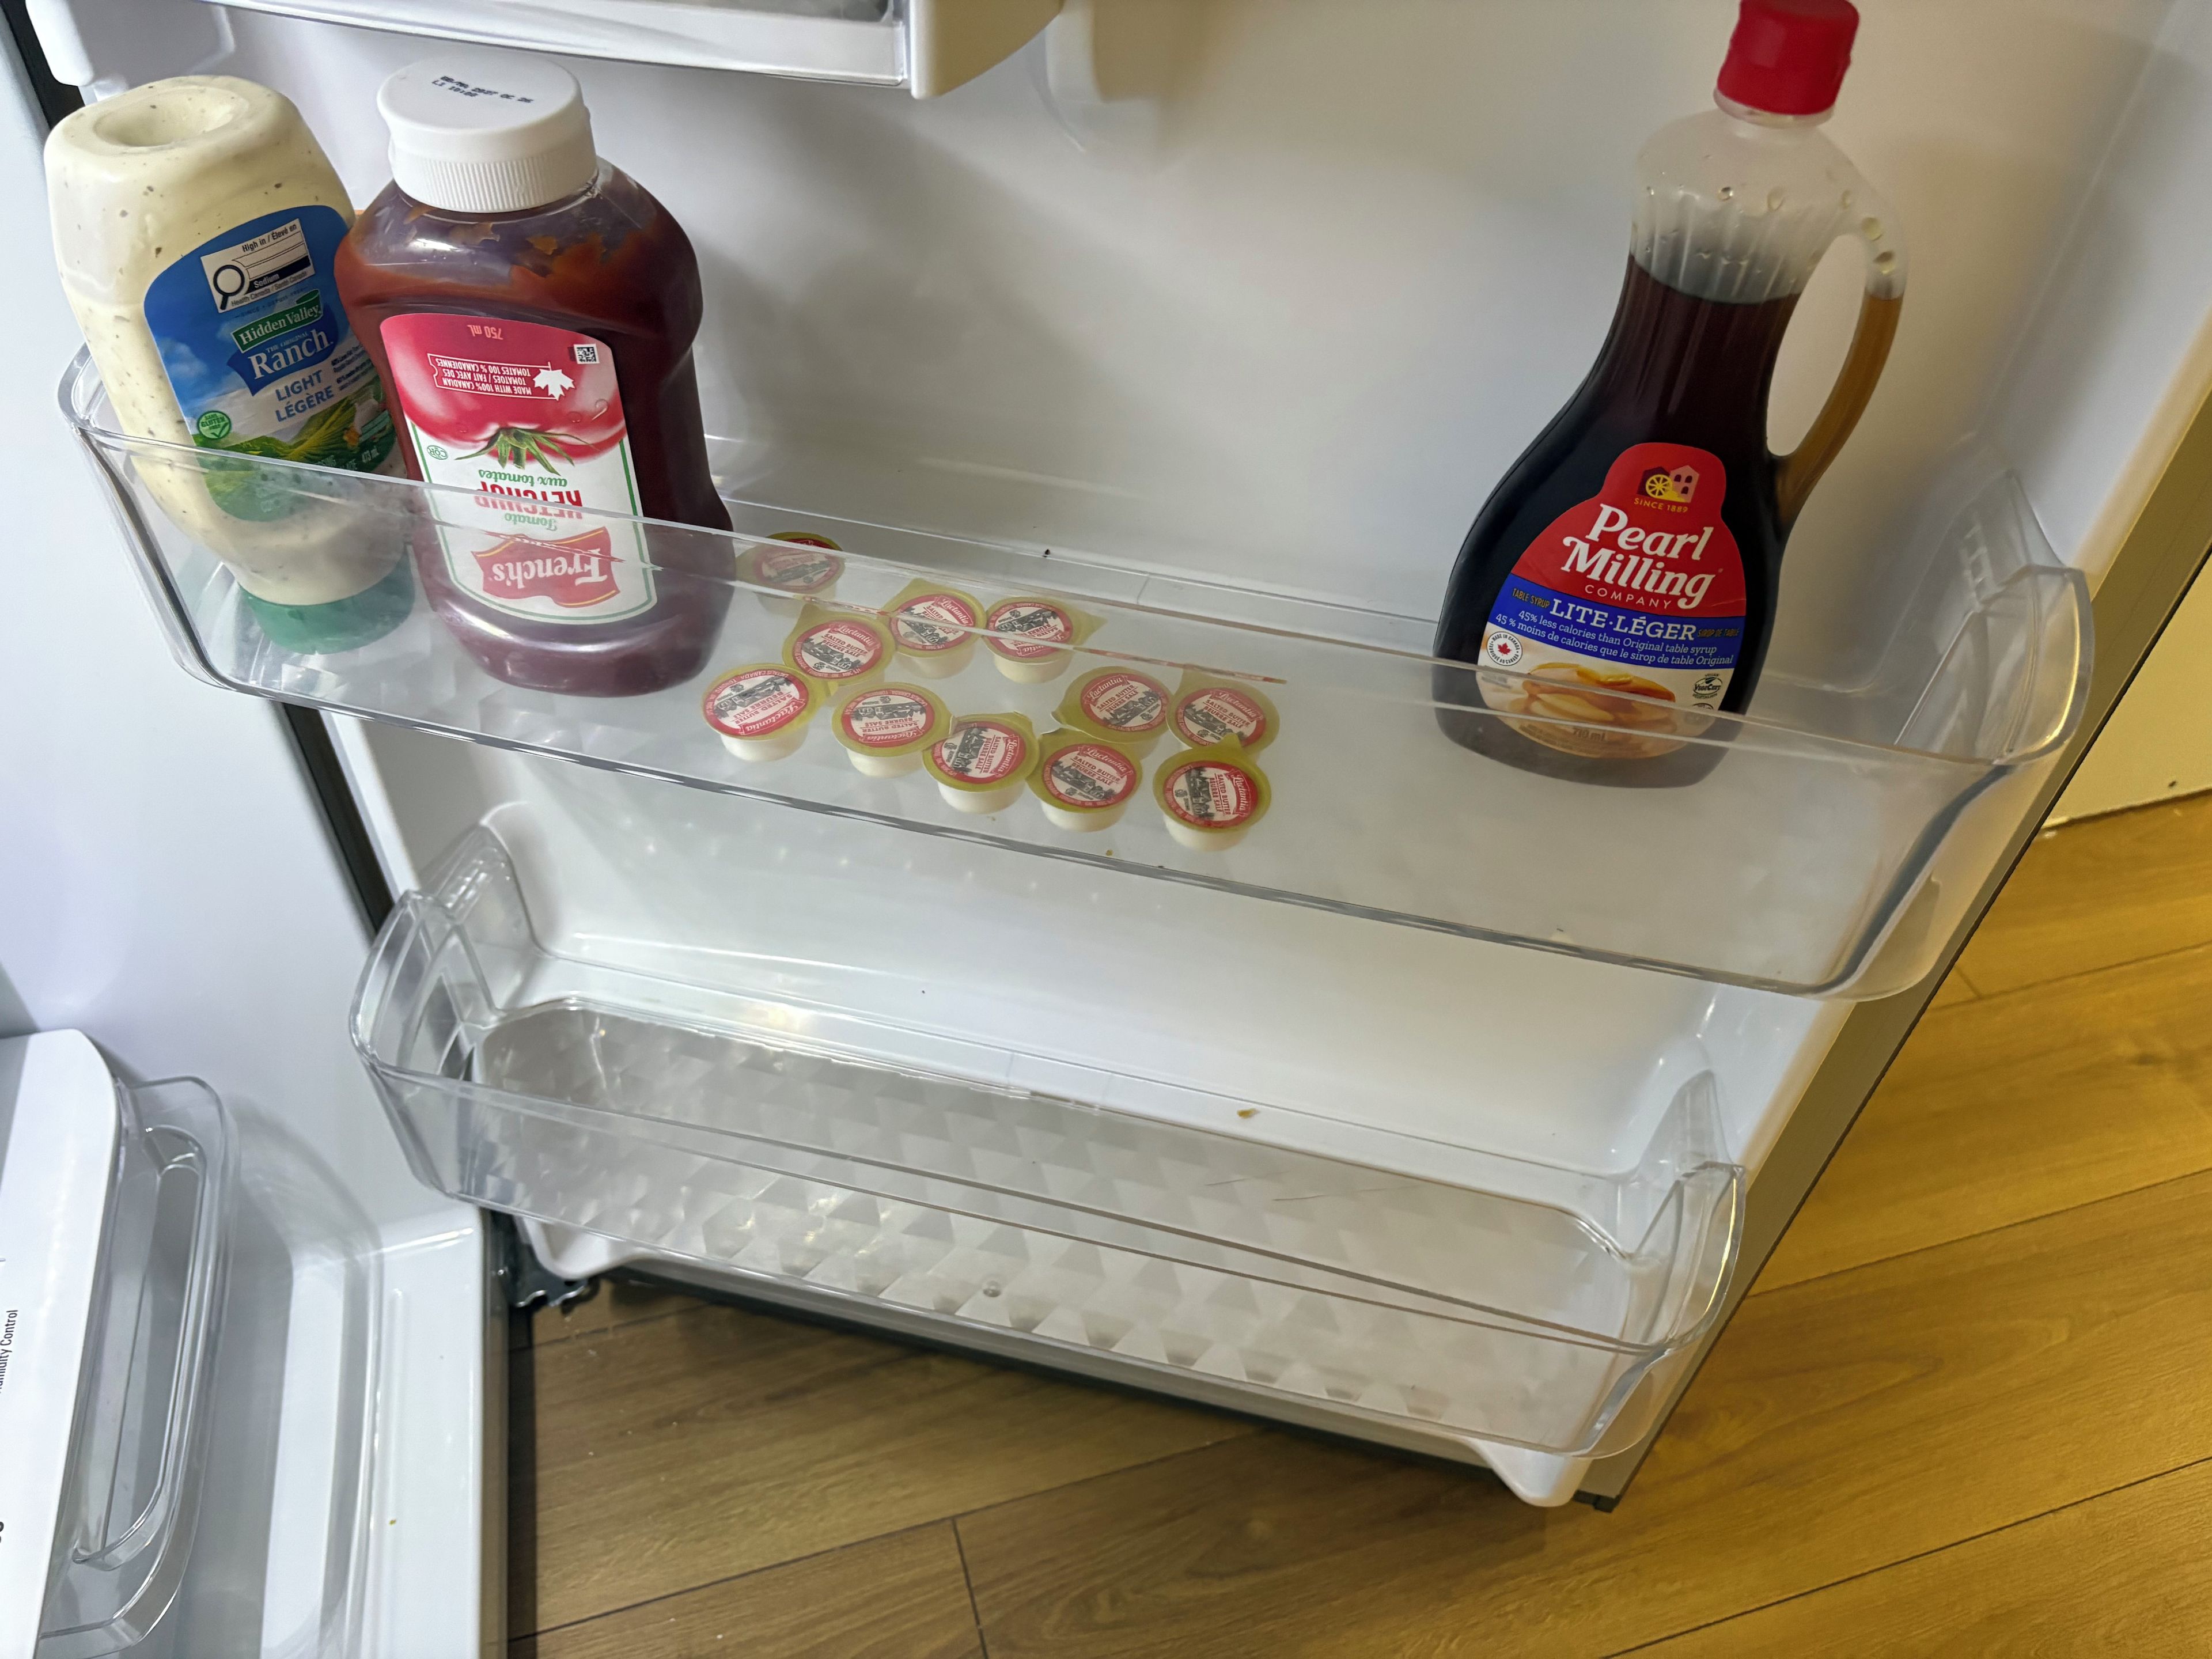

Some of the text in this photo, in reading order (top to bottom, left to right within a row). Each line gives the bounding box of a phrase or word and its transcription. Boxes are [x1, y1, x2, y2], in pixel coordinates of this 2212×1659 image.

[242, 241, 258, 252] High
[253, 274, 279, 288] Sodium
[232, 295, 249, 306] Health
[250, 285, 270, 300] Canada
[238, 317, 287, 344] Hidden
[286, 305, 321, 324] Valley
[467, 324, 503, 340] 750 mL
[266, 331, 309, 353] THE ORIGINAL
[248, 329, 330, 380] Ranch
[435, 358, 531, 377] TOMATES 100 % CANADIENNES
[443, 368, 455, 377] DES
[457, 370, 472, 380] AVEC
[474, 373, 488, 382] FAIT
[275, 370, 323, 401] LIGHT
[442, 377, 532, 395] MADE WITH 100% CANADIAN
[494, 376, 527, 385] TOMATOES
[275, 385, 334, 422] LÉGÈRE
[200, 416, 226, 427] GLUTEN
[478, 469, 567, 487] aux tomates
[474, 480, 583, 519] KETCHUP
[1634, 498, 1688, 513] SINCE 1889
[504, 512, 558, 532] Tomato
[1585, 503, 1714, 560] Pearl
[492, 547, 608, 589] French's
[1560, 536, 1716, 609] Milling
[1512, 588, 1550, 608] TABLE SYRUP
[1585, 585, 1672, 609] COMPANY
[938, 598, 969, 625] Lactantia
[824, 634, 846, 646] SALTED
[837, 624, 874, 646] Lactantia
[1496, 613, 1734, 666] 45 % moins de calories que le sirop de table Original
[1508, 636, 1520, 650] CANADA
[1518, 611, 1717, 656] 45% less calories than Original table syrup
[741, 670, 766, 679] CANADA
[1087, 677, 1123, 700] Lactantia
[749, 691, 784, 710] BEURRE
[761, 694, 793, 711] SALTED
[1097, 697, 1115, 710] SALTED
[1206, 699, 1228, 713] SALTED
[1219, 692, 1257, 717] Lactantia
[745, 702, 799, 732] Lactantia
[866, 730, 916, 741] Lactantia
[990, 736, 1001, 754] SALTED
[998, 738, 1018, 772] Lactantia
[1073, 756, 1097, 770] SALTED
[1086, 748, 1127, 771] Lactantia
[1210, 778, 1218, 798] BEURRE
[1217, 774, 1231, 815] SALTED BUTTER
[1233, 774, 1249, 811] Lactantia
[0, 1309, 18, 1346] Control
